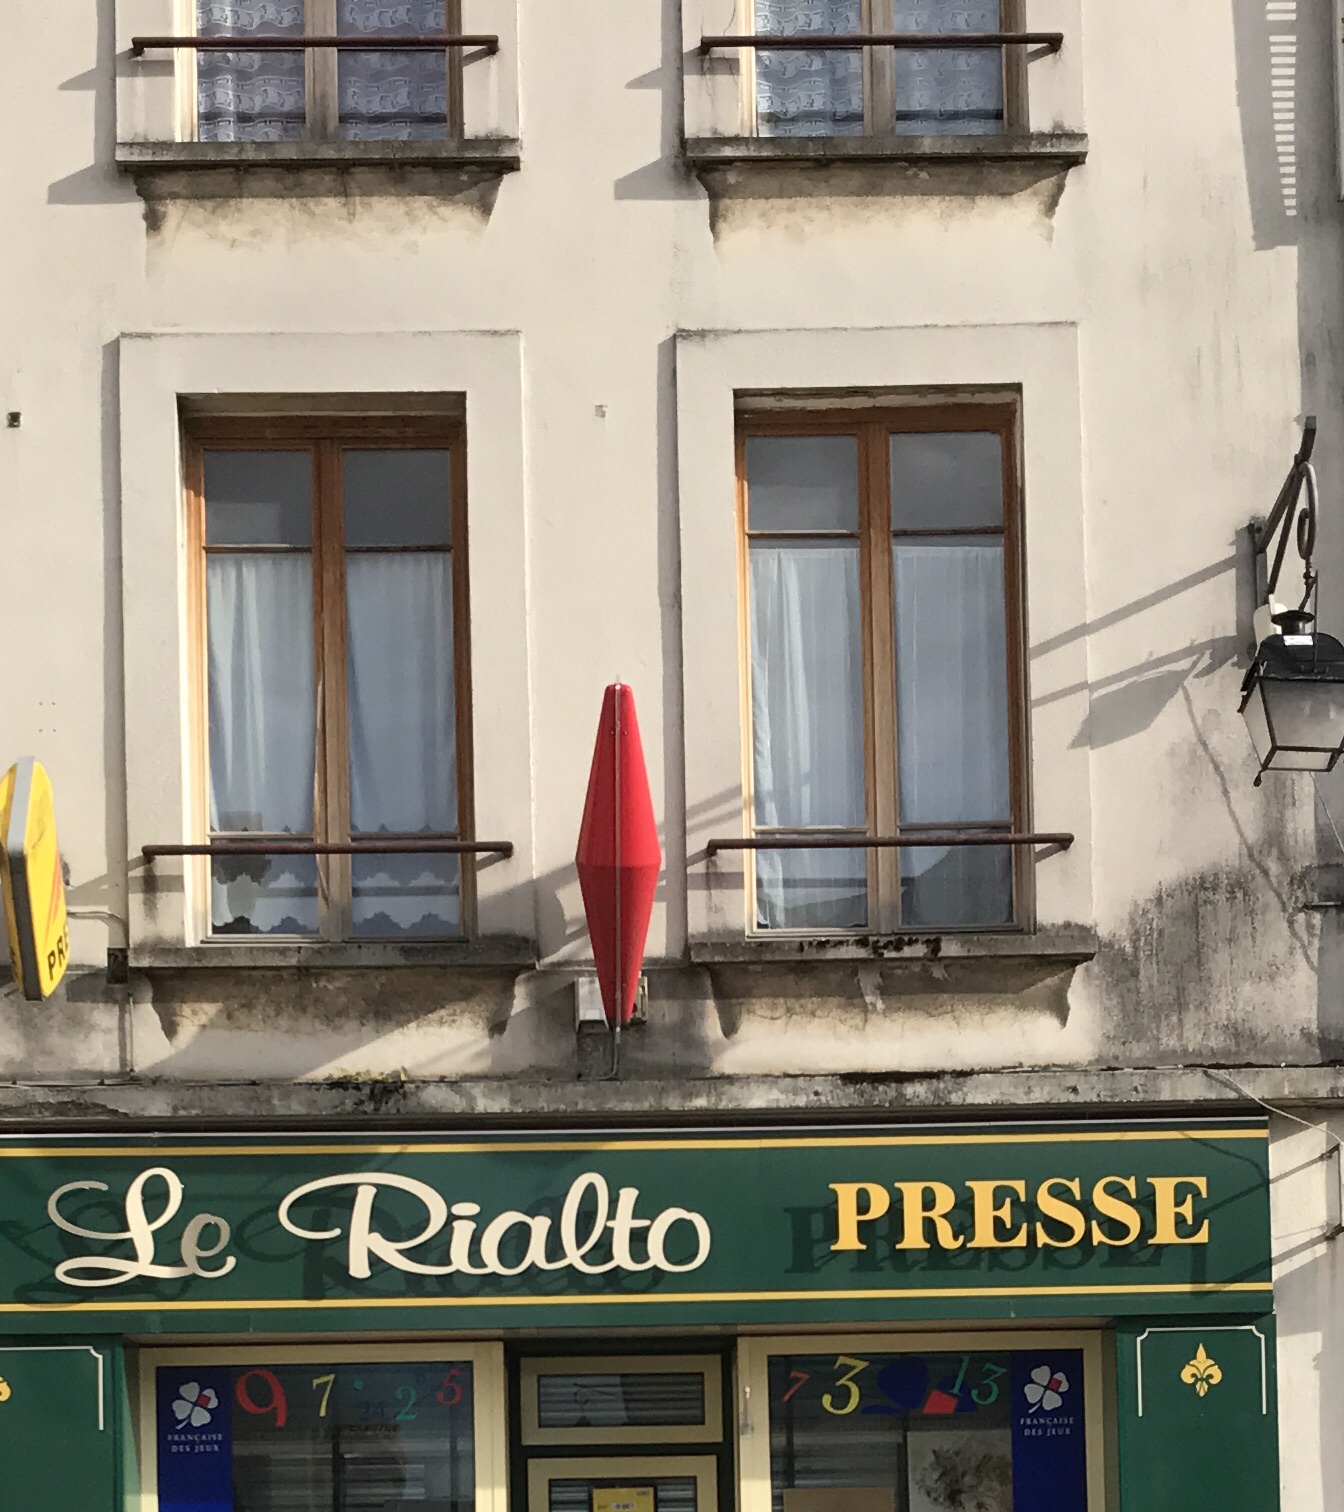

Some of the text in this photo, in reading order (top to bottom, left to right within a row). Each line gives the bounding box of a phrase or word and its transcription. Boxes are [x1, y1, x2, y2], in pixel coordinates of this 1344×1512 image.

[46, 1166, 712, 1288] Le Rialto
[827, 1175, 1211, 1252] PRESSE
[234, 1369, 288, 1428] 9
[311, 1374, 336, 1417] 7
[436, 1369, 465, 1405] 5
[781, 1371, 810, 1402] 7
[822, 1355, 869, 1415] 3
[395, 1386, 418, 1421] 2
[167, 1433, 223, 1443] FRANÇAISE
[1019, 1417, 1075, 1427] FRANÇAISE
[1023, 1428, 1071, 1437] DES JEUX
[170, 1444, 220, 1454] DES JEUX
